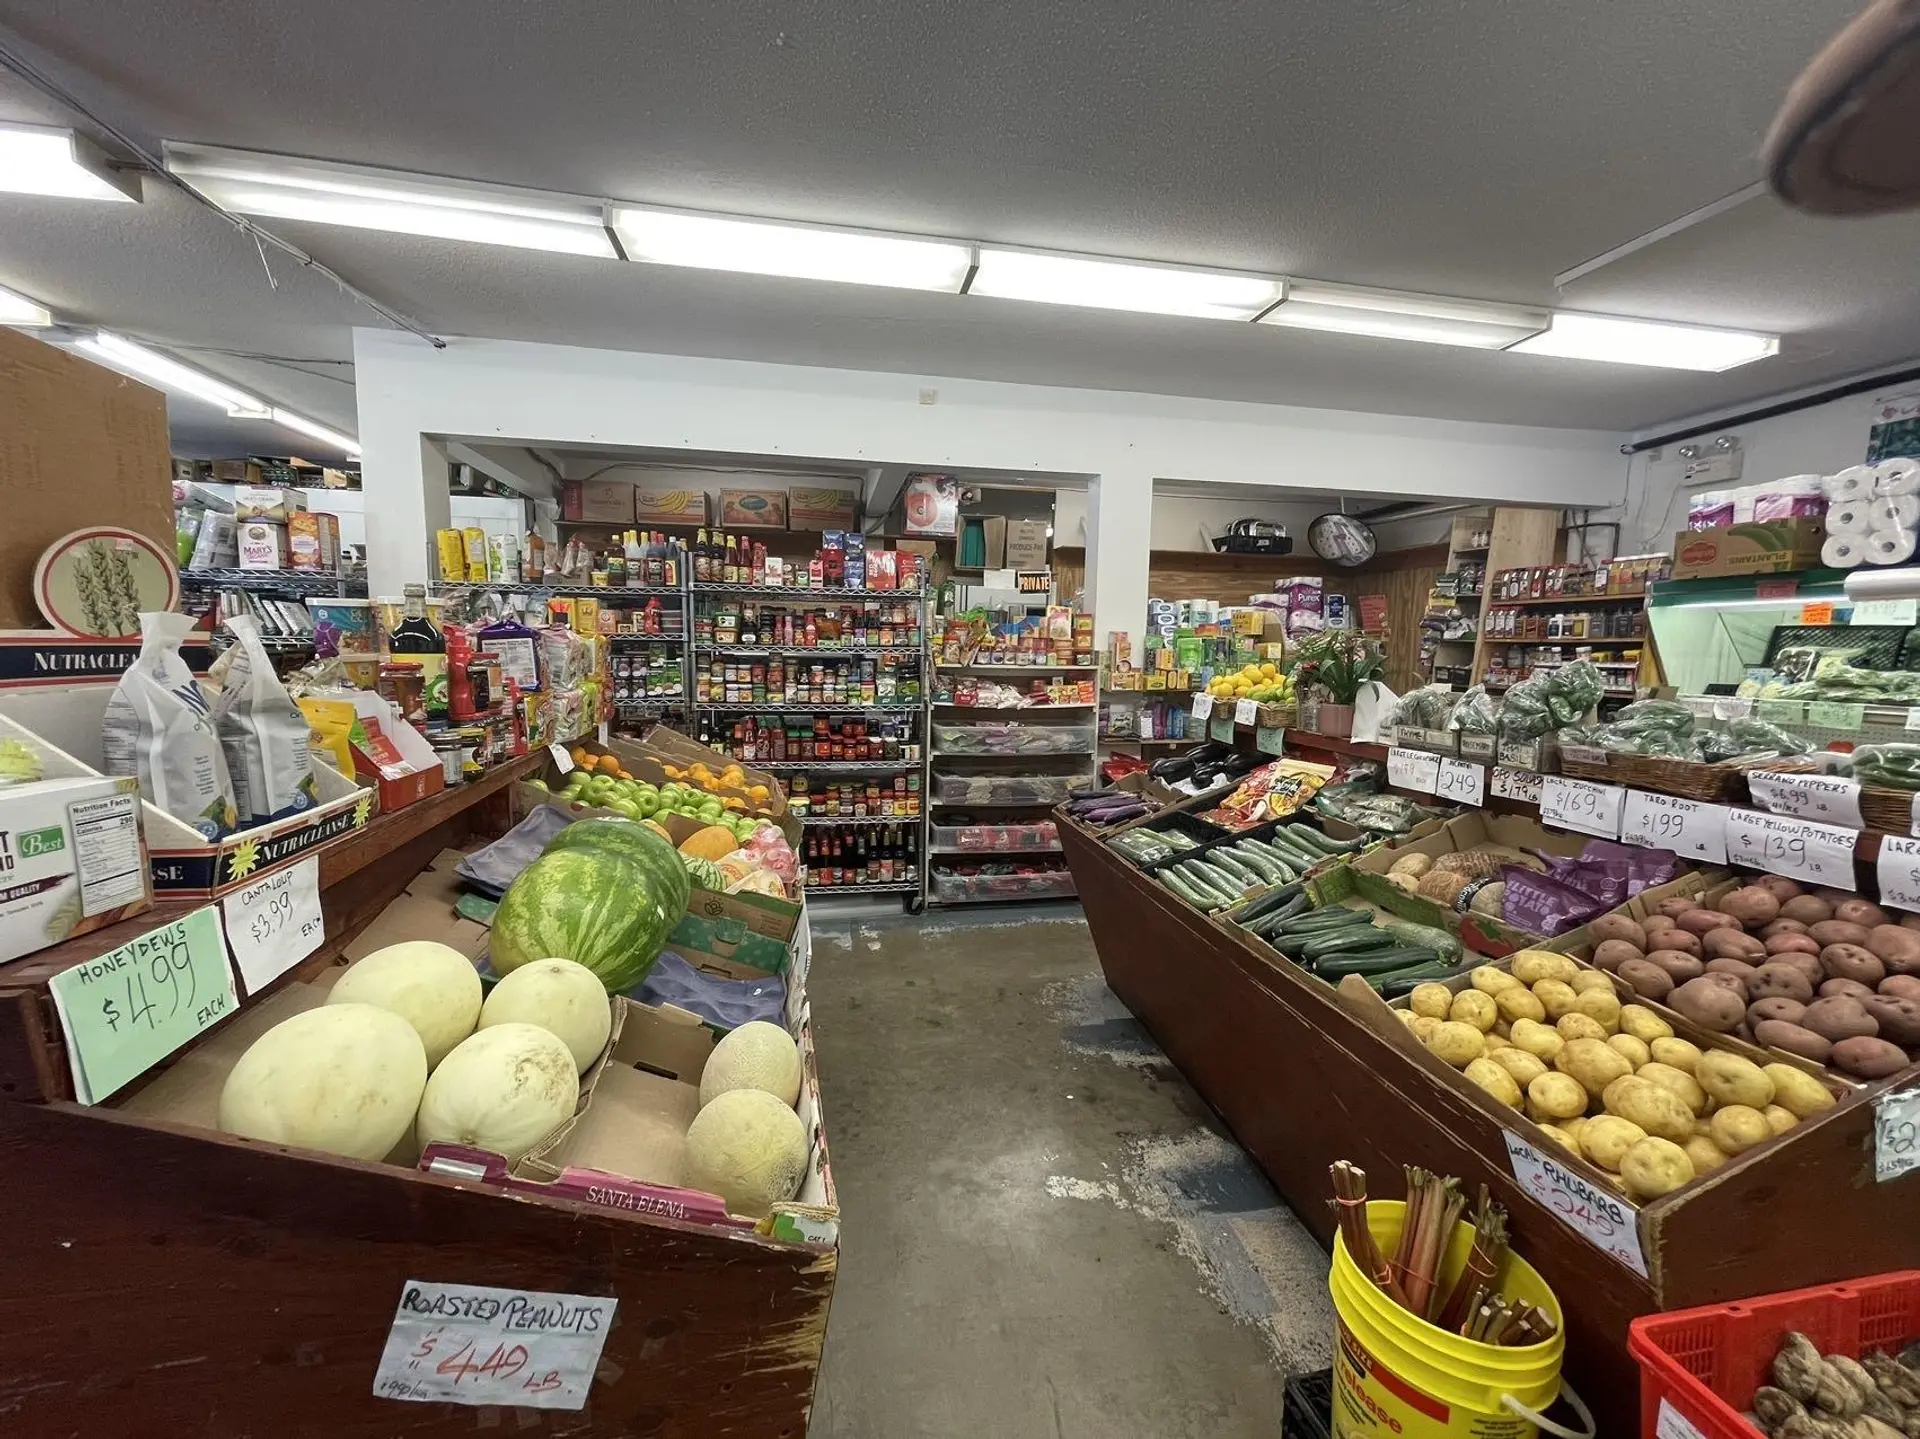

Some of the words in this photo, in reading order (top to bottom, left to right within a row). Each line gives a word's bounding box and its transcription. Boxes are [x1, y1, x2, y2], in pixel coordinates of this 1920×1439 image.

[1020, 577, 1049, 590] PRIVATE
[1298, 593, 1320, 603] Purex
[1547, 778, 1567, 787] LOCAL
[1751, 772, 1795, 784] SERRANO
[1798, 779, 1848, 794] PEPPERS
[73, 802, 109, 815] Nutrition
[110, 797, 131, 808] Facts
[1643, 794, 1666, 805] TARO
[1671, 799, 1699, 812] ROOT
[119, 816, 134, 826] 290
[1730, 811, 1763, 826] LARGE
[1763, 817, 1800, 834] YELLOW
[1801, 826, 1855, 849] POTATOES
[22, 834, 62, 855] Best
[261, 813, 350, 863] NUTRACLEANSE
[241, 871, 293, 905] CANTALOUP
[1511, 882, 1559, 907] LITTLE
[251, 892, 293, 943] $3.99
[301, 917, 321, 937] EACH
[78, 922, 187, 985] HONEYDEWS
[197, 993, 225, 1026] EACH
[586, 1186, 632, 1209] SANTA
[637, 1196, 684, 1218] ELENA
[1543, 1161, 1624, 1226] RHUBARB
[402, 1288, 500, 1320] ROASTED
[502, 1297, 602, 1332] PEANUTS
